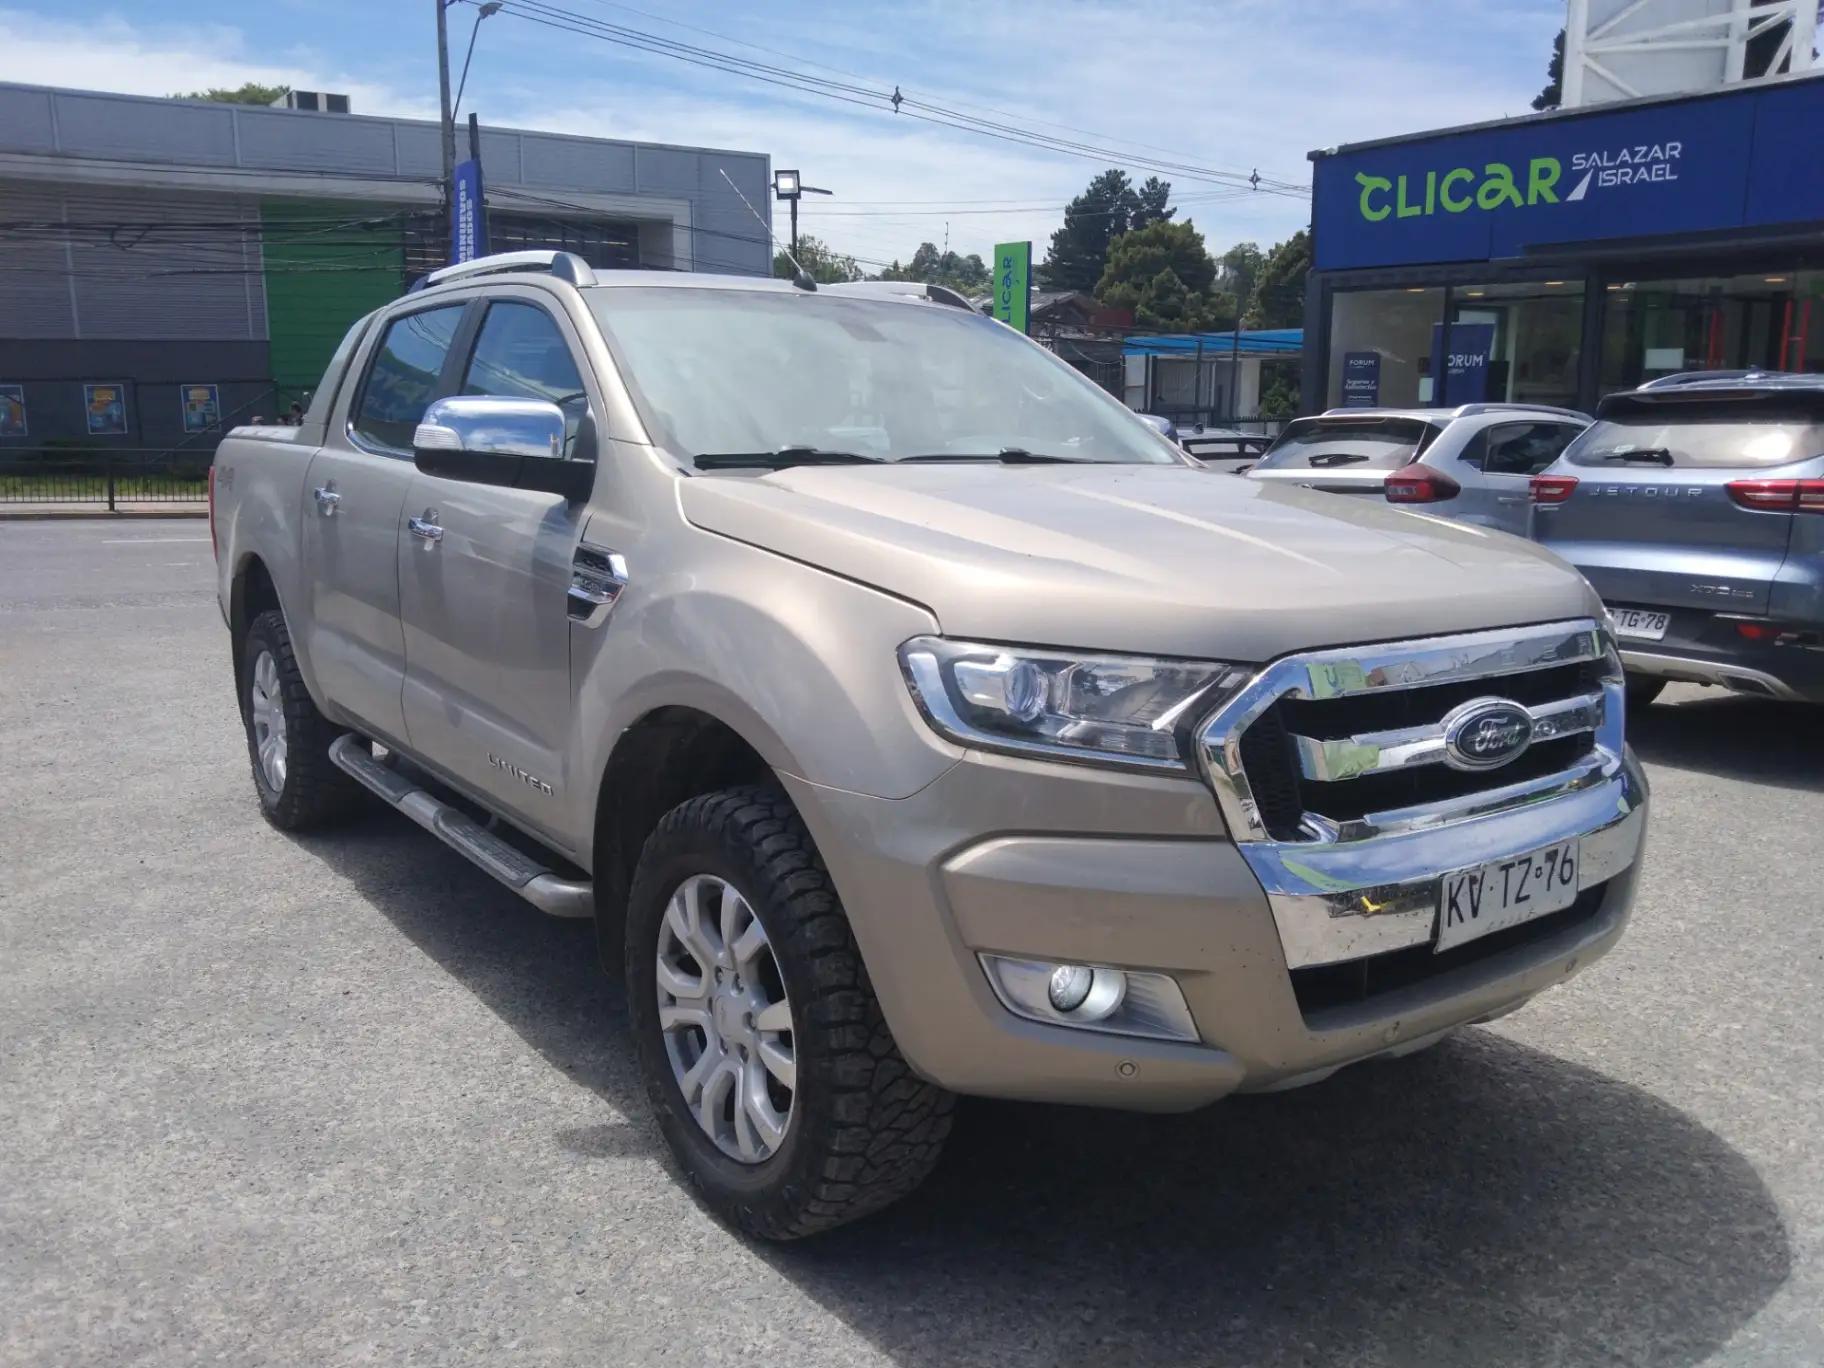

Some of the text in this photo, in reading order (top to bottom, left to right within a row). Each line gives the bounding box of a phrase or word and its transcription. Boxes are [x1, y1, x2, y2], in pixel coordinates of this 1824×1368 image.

[1571, 141, 1682, 170] SALAZAR
[1598, 163, 1679, 187] ISRAEL
[1447, 354, 1484, 367] ORUM
[1589, 486, 1703, 497] JETOUR
[1474, 716, 1521, 753] Ford
[486, 752, 554, 797] LIMITED
